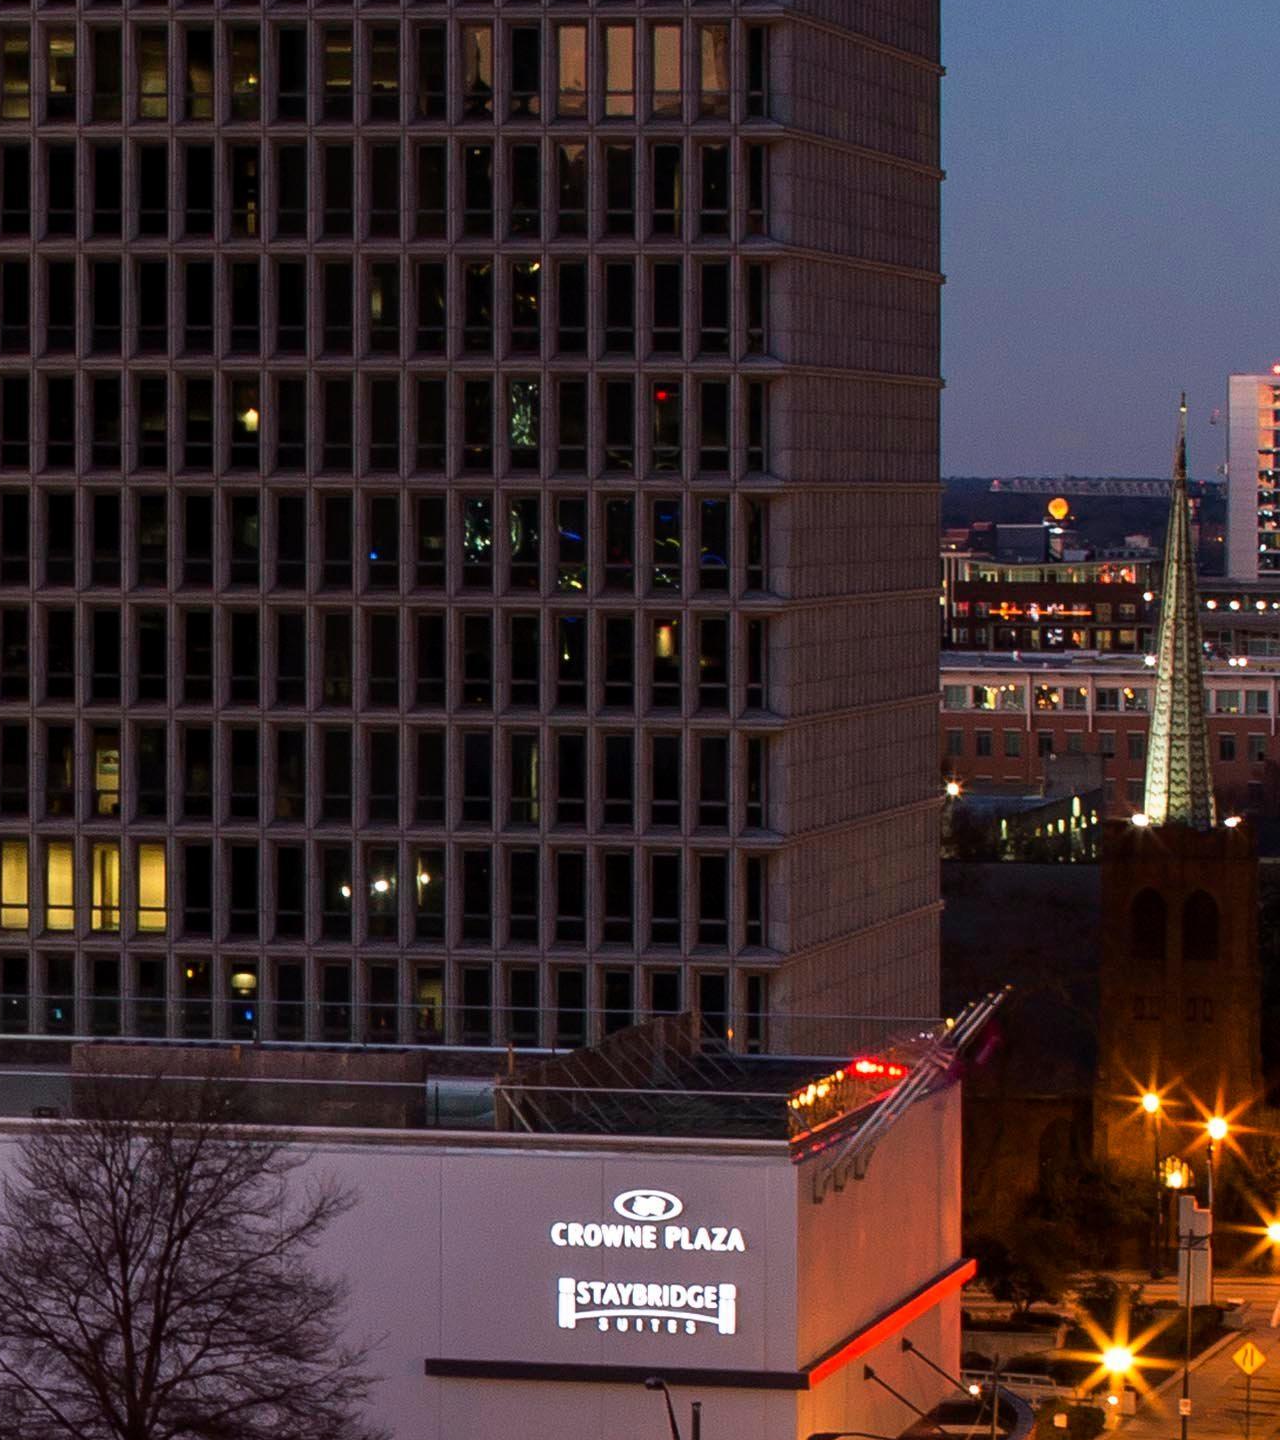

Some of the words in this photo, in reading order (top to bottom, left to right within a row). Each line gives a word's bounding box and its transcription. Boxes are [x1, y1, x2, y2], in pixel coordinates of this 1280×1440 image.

[550, 1222, 657, 1249] CROWNE
[665, 1225, 745, 1252] PLAZA
[576, 1281, 718, 1309] STAYBRIDGE
[598, 1317, 696, 1335] SUITES
